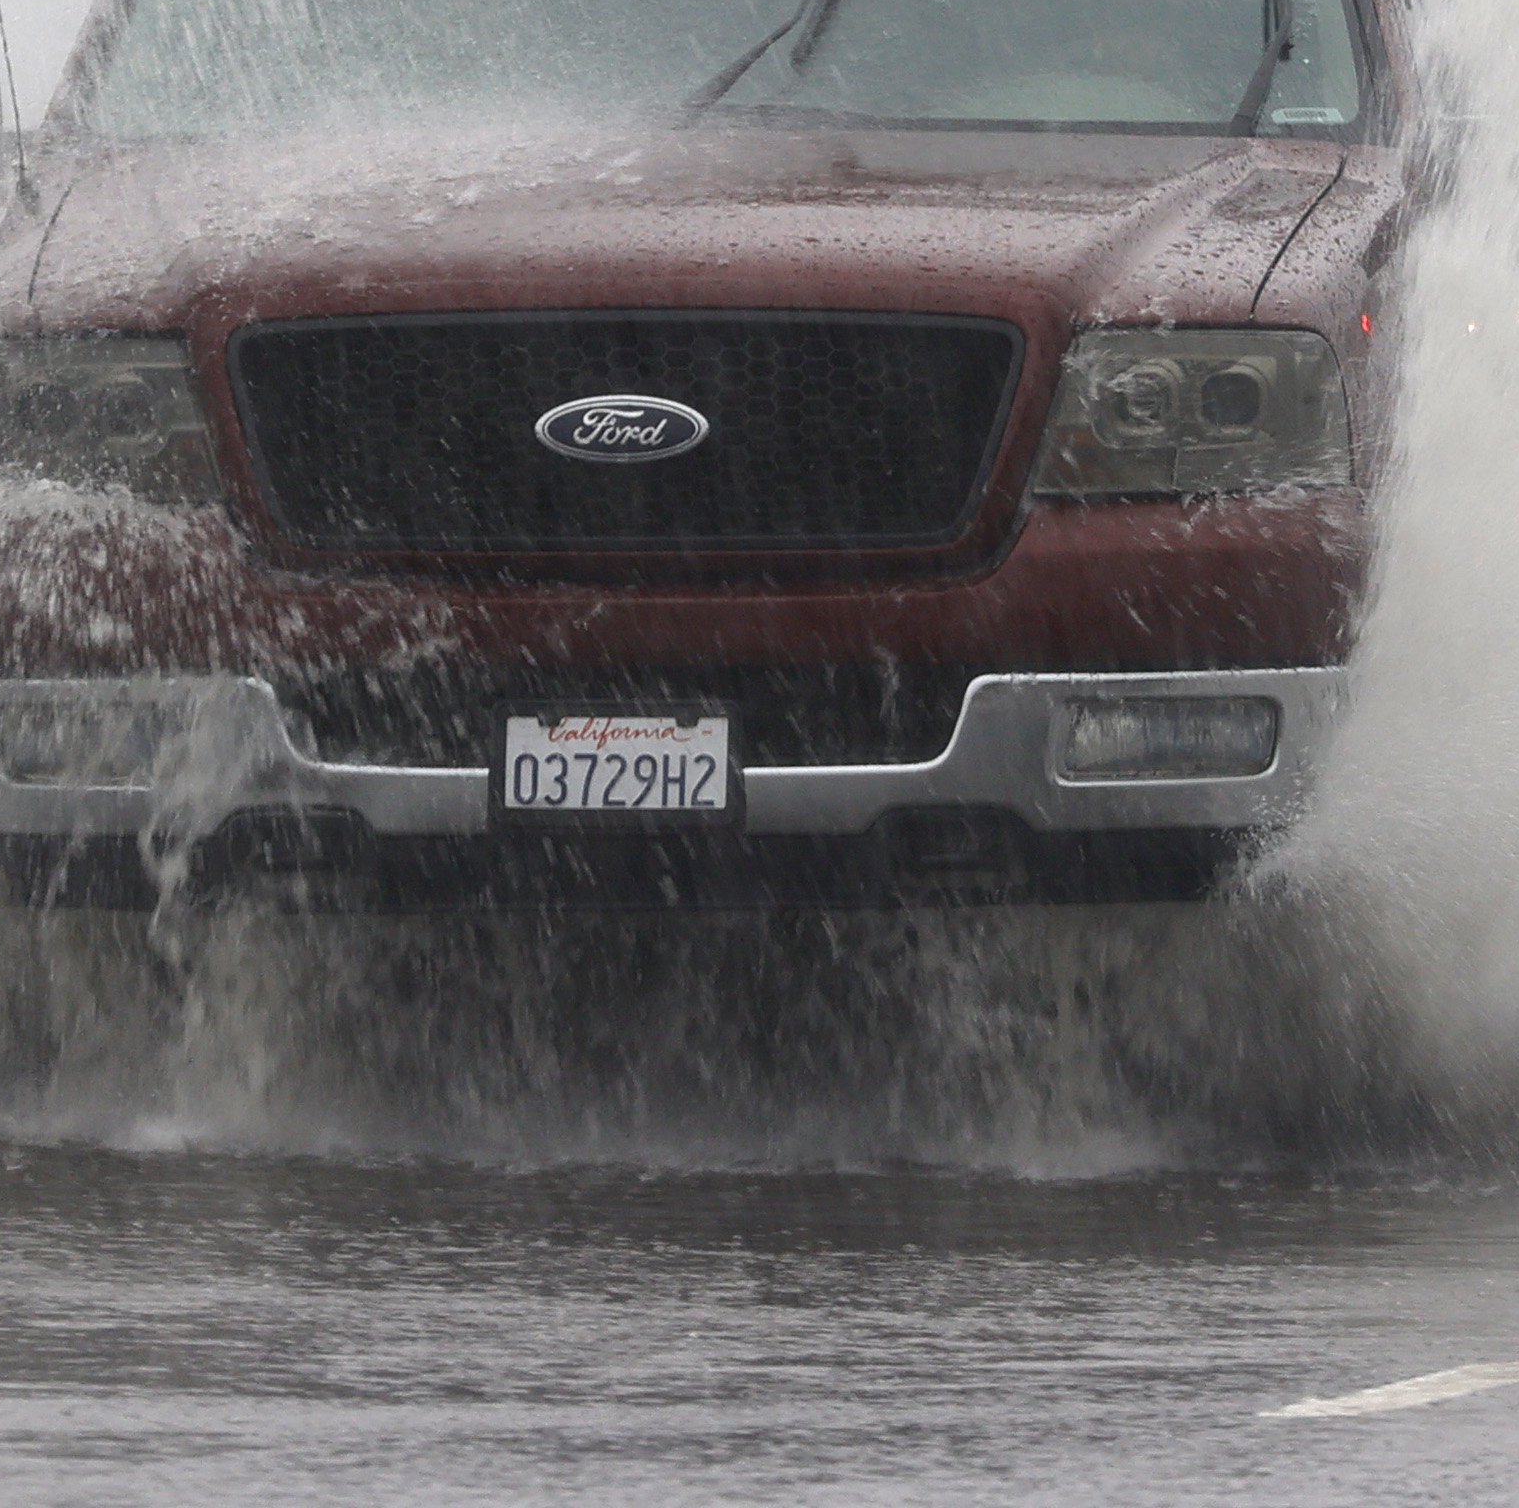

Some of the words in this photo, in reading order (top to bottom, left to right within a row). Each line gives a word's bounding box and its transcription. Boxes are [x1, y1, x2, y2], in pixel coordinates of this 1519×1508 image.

[573, 408, 668, 446] Ford
[548, 716, 691, 750] California
[513, 752, 717, 806] 03729H2
